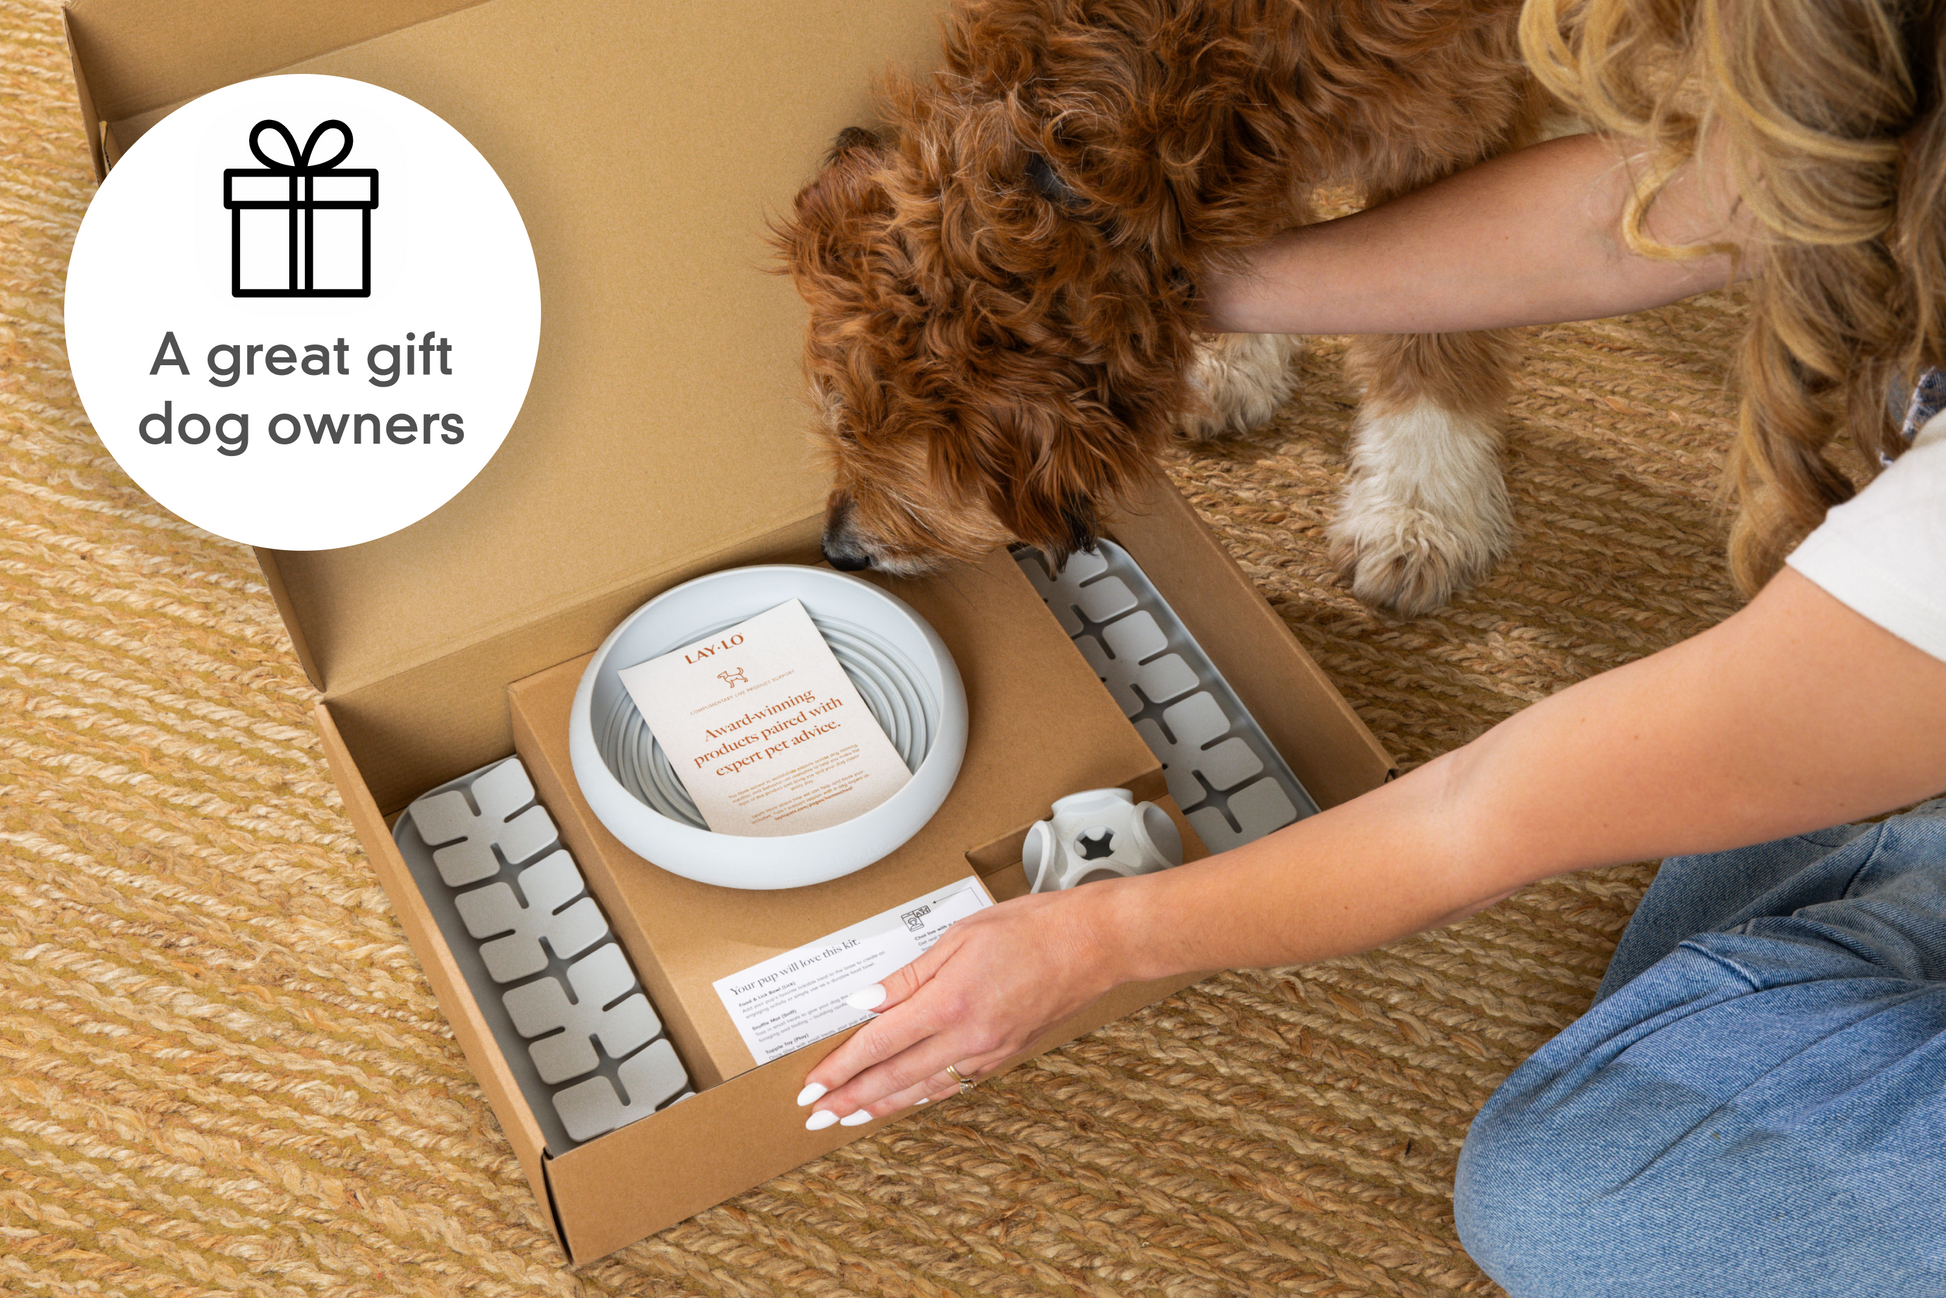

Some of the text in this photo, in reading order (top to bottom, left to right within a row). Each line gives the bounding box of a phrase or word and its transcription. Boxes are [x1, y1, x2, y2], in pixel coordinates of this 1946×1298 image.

[690, 695, 733, 715] COMPLIMENTARY
[747, 680, 771, 692] PRODUCT
[772, 670, 795, 682] SUPPORT
[705, 690, 815, 742] Award-winning
[694, 698, 843, 769] products paired with
[716, 720, 841, 776] expert pet advice.
[730, 939, 860, 996] Your pup will love this kit.
[738, 999, 752, 1007] Food
[781, 981, 795, 990] (Lick)
[752, 1021, 769, 1030] Snuffle
[758, 1031, 780, 1042] foraging
[790, 1019, 808, 1028] finding
[772, 1021, 786, 1029] small
[837, 1024, 849, 1032] your
[765, 1045, 783, 1054] Topple
[793, 1033, 809, 1042] (Play)
